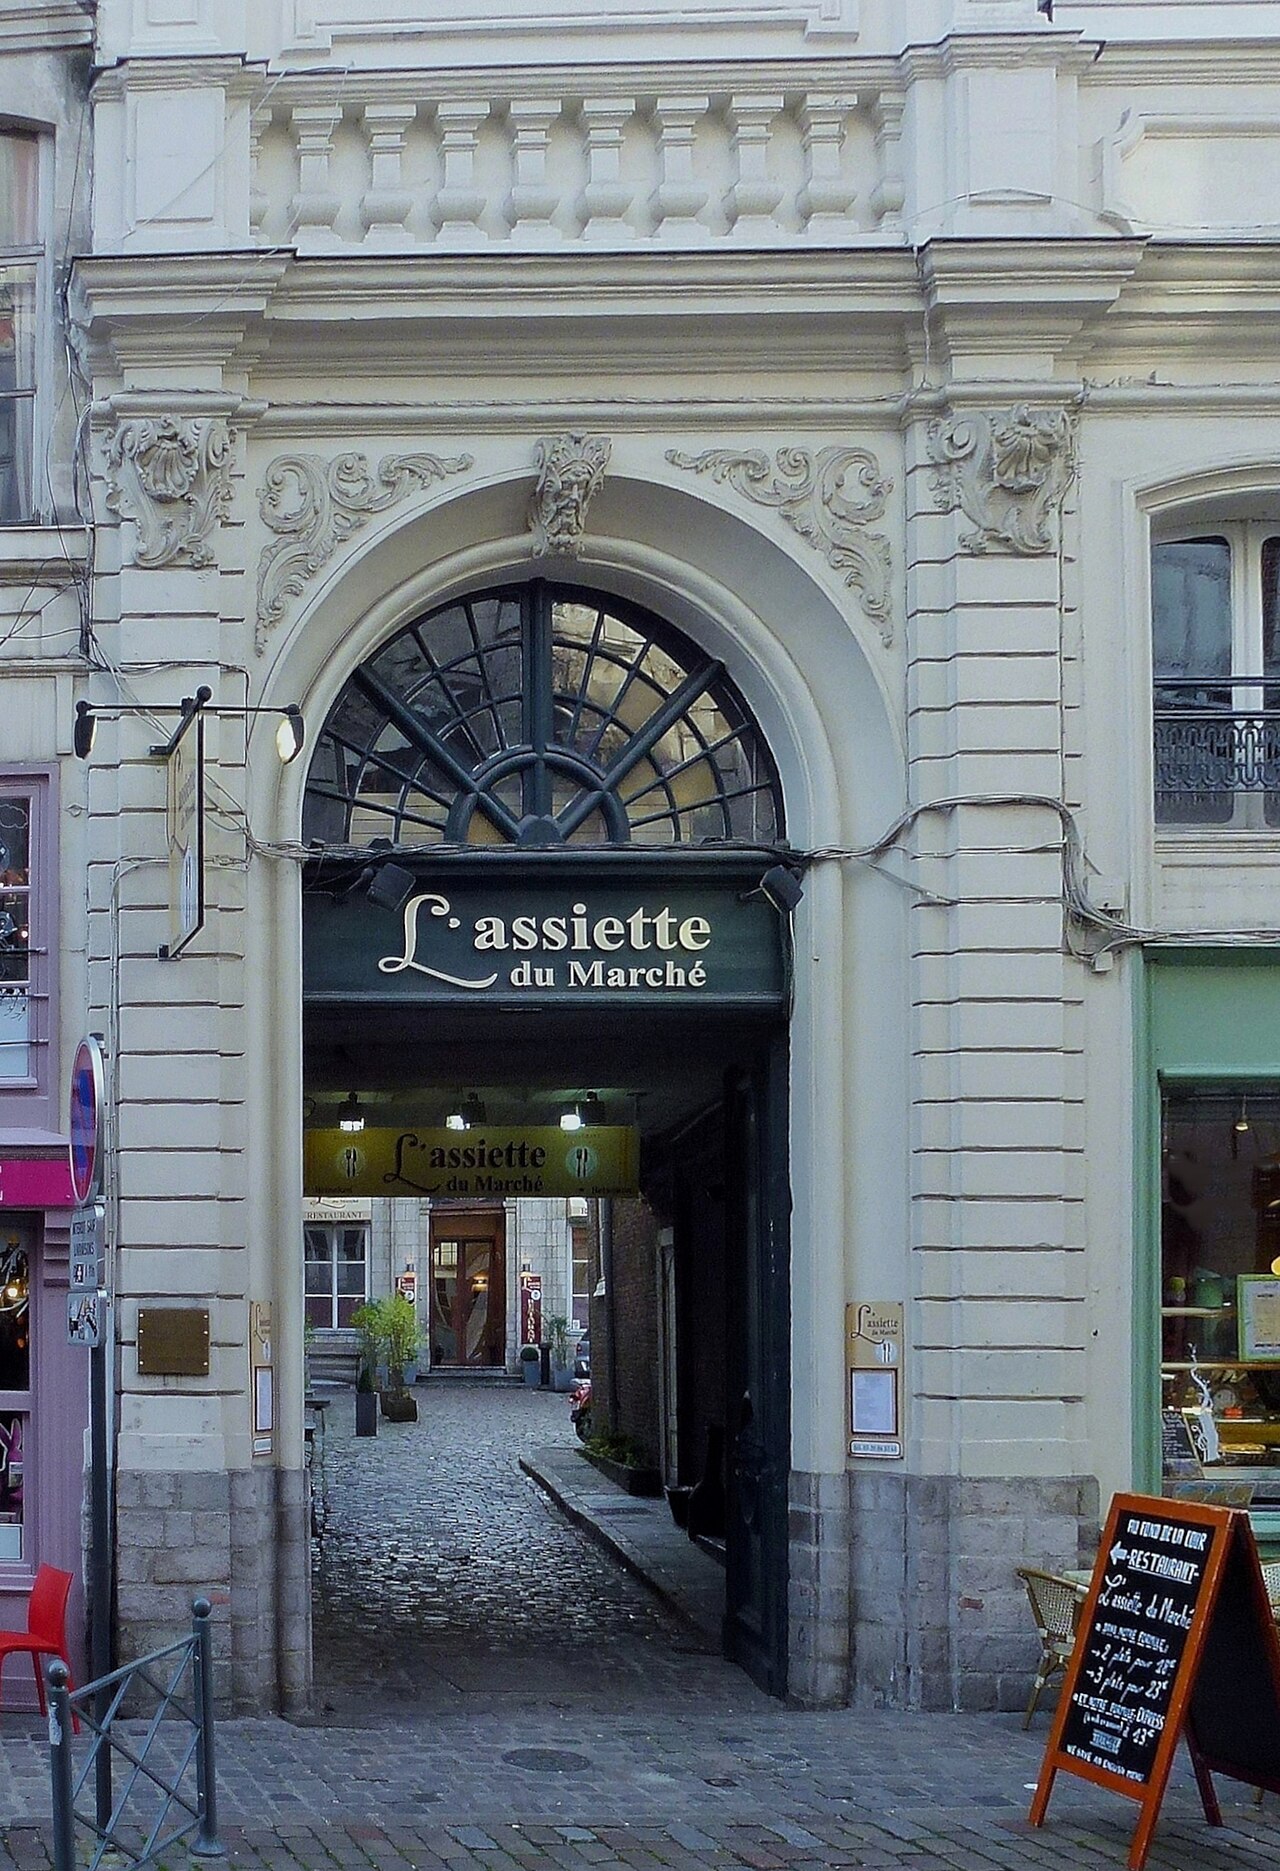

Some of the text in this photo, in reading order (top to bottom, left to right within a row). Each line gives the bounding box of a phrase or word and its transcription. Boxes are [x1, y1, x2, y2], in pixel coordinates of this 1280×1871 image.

[378, 893, 711, 989] L'assiette
[510, 960, 707, 988] du Marché
[383, 1133, 547, 1193] L'assiette
[446, 1175, 543, 1193] du Marché
[307, 1211, 363, 1220] RESTAURANT
[1171, 1528, 1184, 1545] LA
[1159, 1597, 1195, 1630] Marché
[1101, 1643, 1111, 1661] 2
[1107, 1646, 1132, 1668] plats
[1094, 1666, 1104, 1684] 3
[1099, 1671, 1125, 1694] plats
